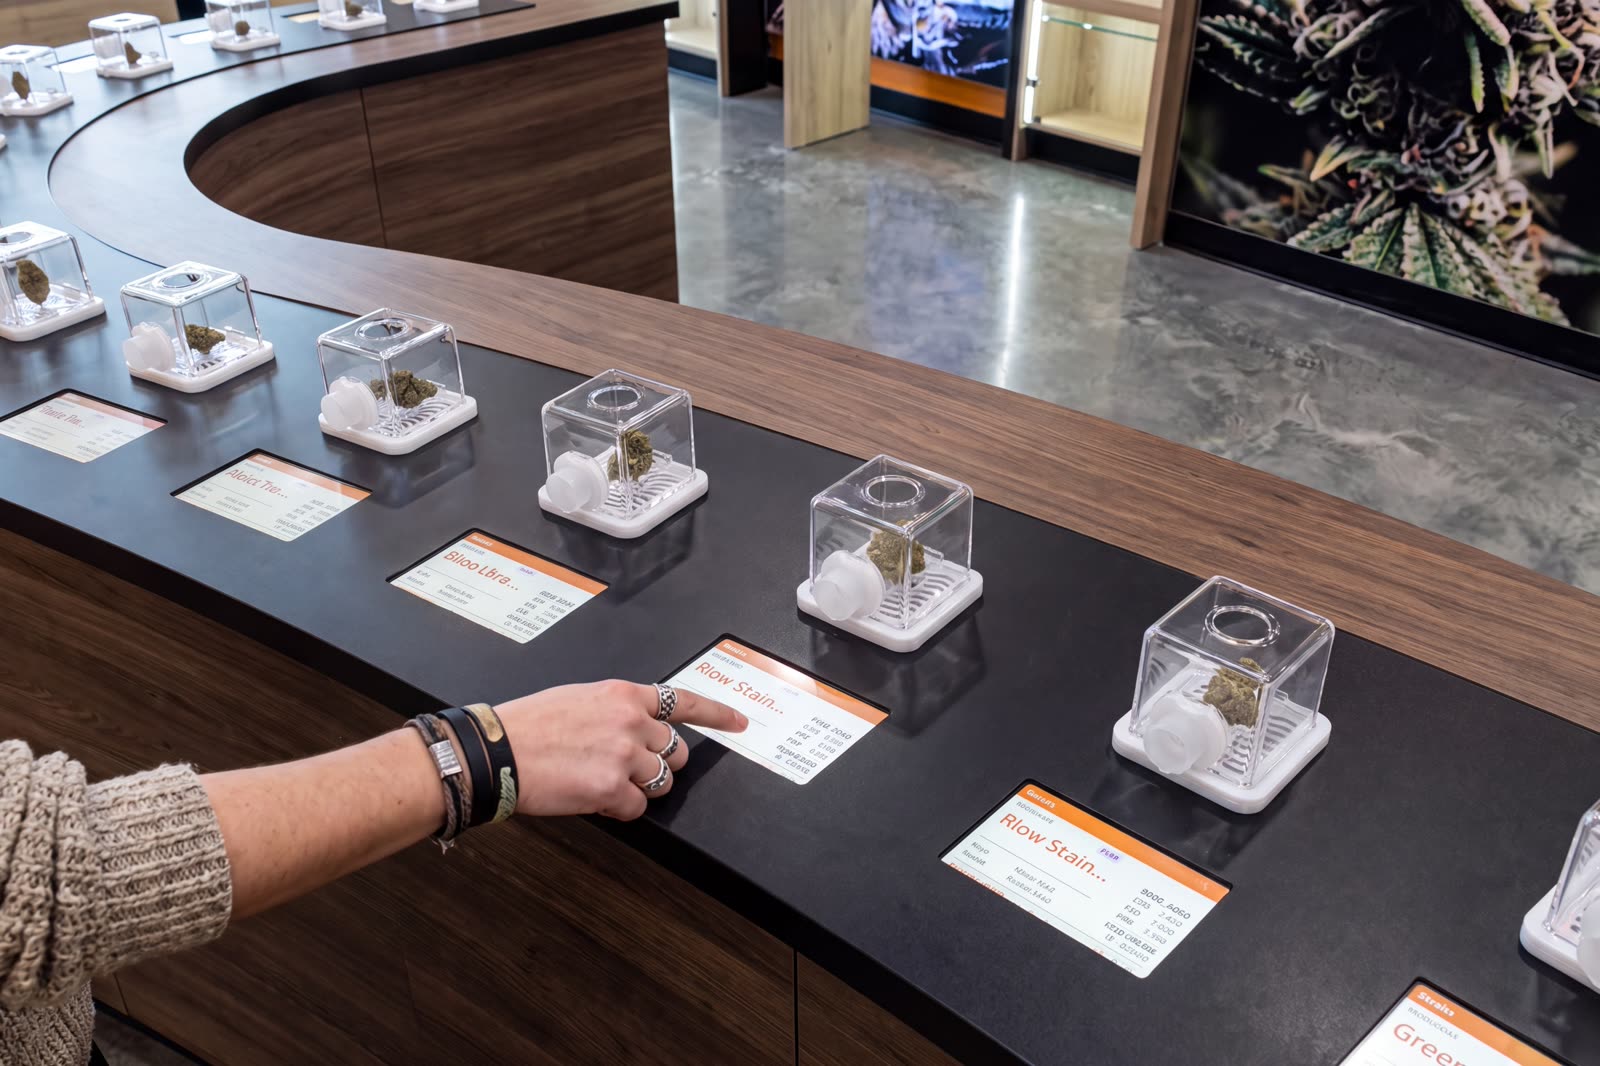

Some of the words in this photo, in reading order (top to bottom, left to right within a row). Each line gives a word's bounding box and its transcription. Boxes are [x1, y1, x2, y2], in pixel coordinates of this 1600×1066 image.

[732, 681, 784, 714] Stain...
[999, 812, 1047, 844] Rlow
[1044, 839, 1107, 882] Stain...
